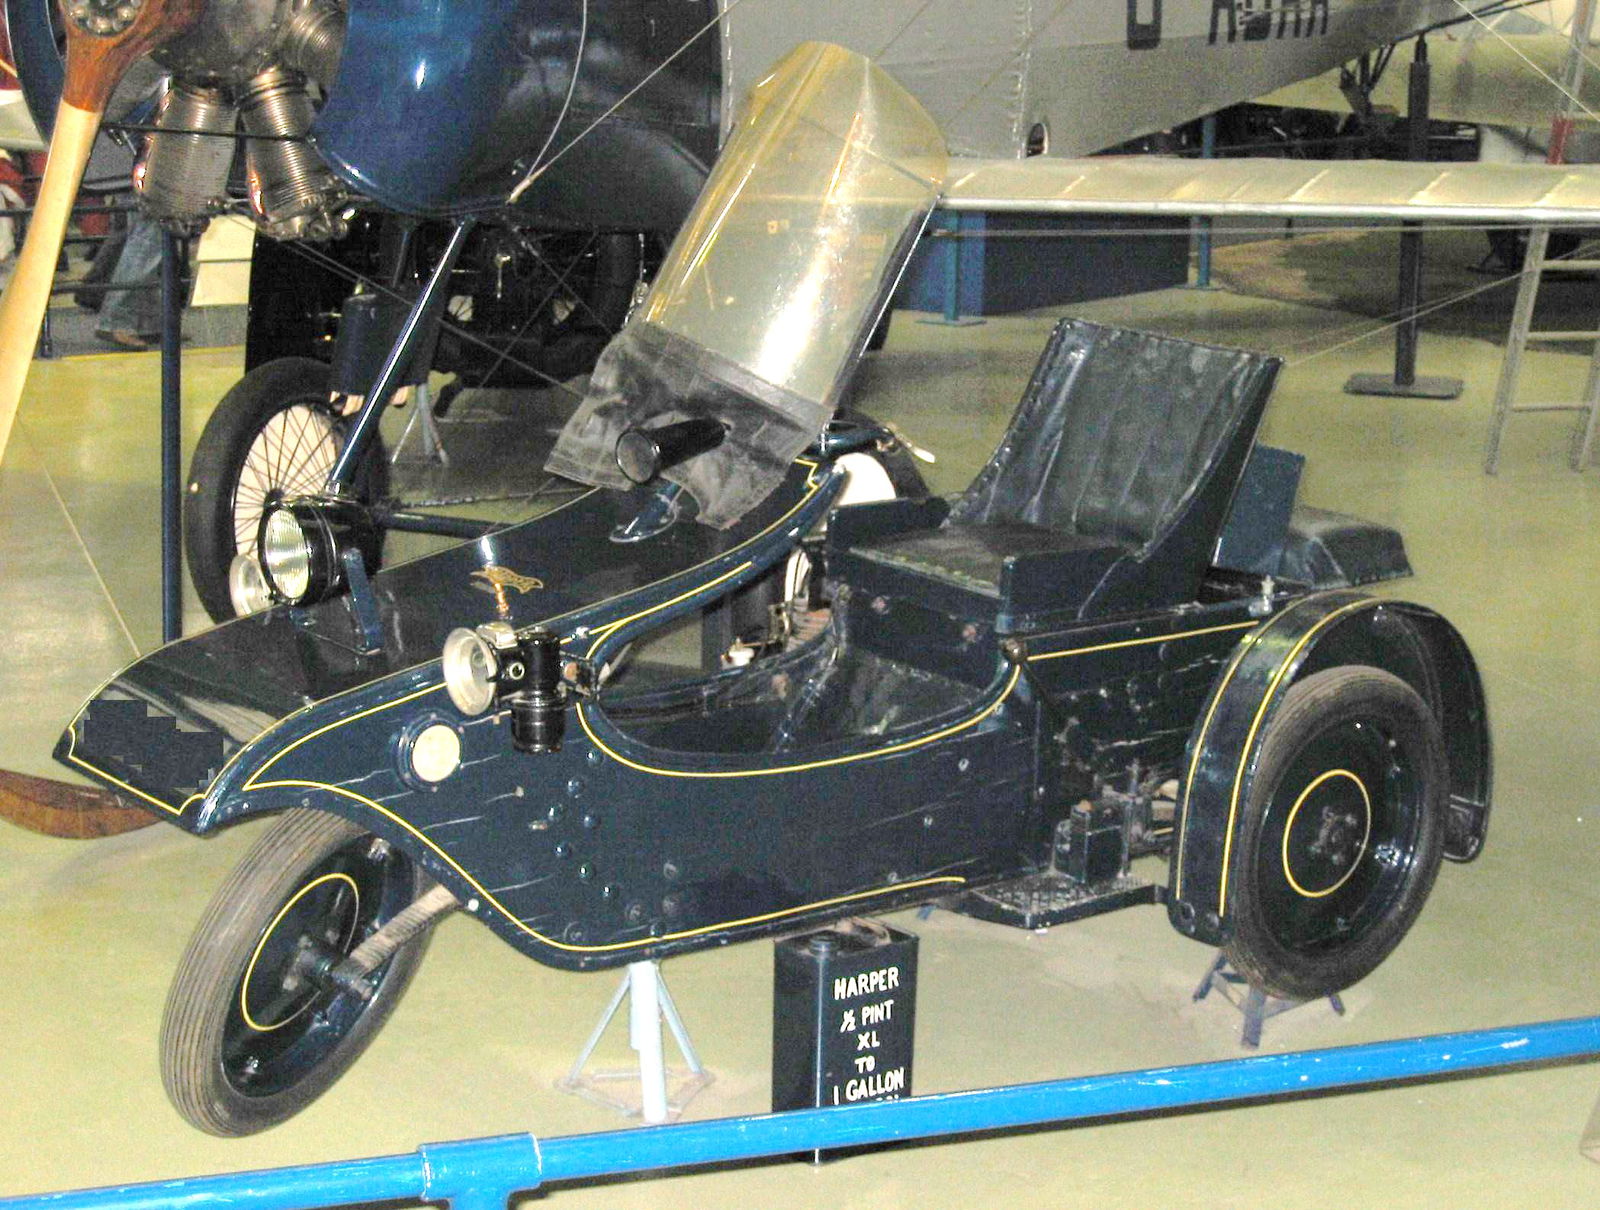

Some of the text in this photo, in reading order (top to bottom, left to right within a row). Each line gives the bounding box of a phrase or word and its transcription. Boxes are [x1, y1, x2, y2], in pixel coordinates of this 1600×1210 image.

[833, 966, 900, 1000] HARPER
[861, 999, 895, 1026] PINT
[857, 1030, 881, 1051] XL
[854, 1055, 876, 1074] TO
[845, 1066, 905, 1101] GALLON
